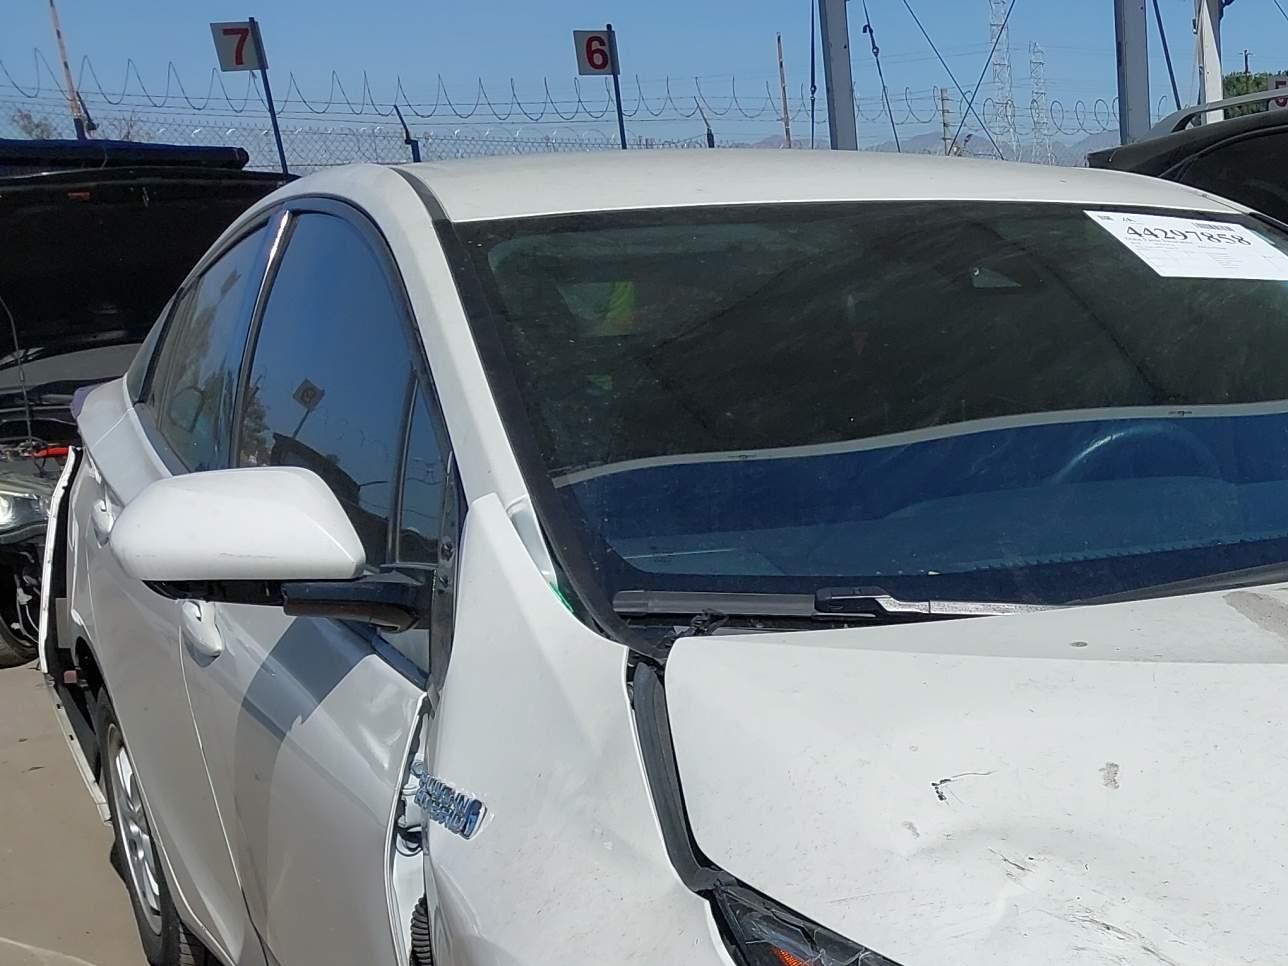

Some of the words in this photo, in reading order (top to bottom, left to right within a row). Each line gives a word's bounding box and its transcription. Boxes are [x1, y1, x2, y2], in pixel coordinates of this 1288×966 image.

[223, 28, 250, 65] 7
[586, 36, 609, 70] 6
[1126, 226, 1252, 246] 44297858
